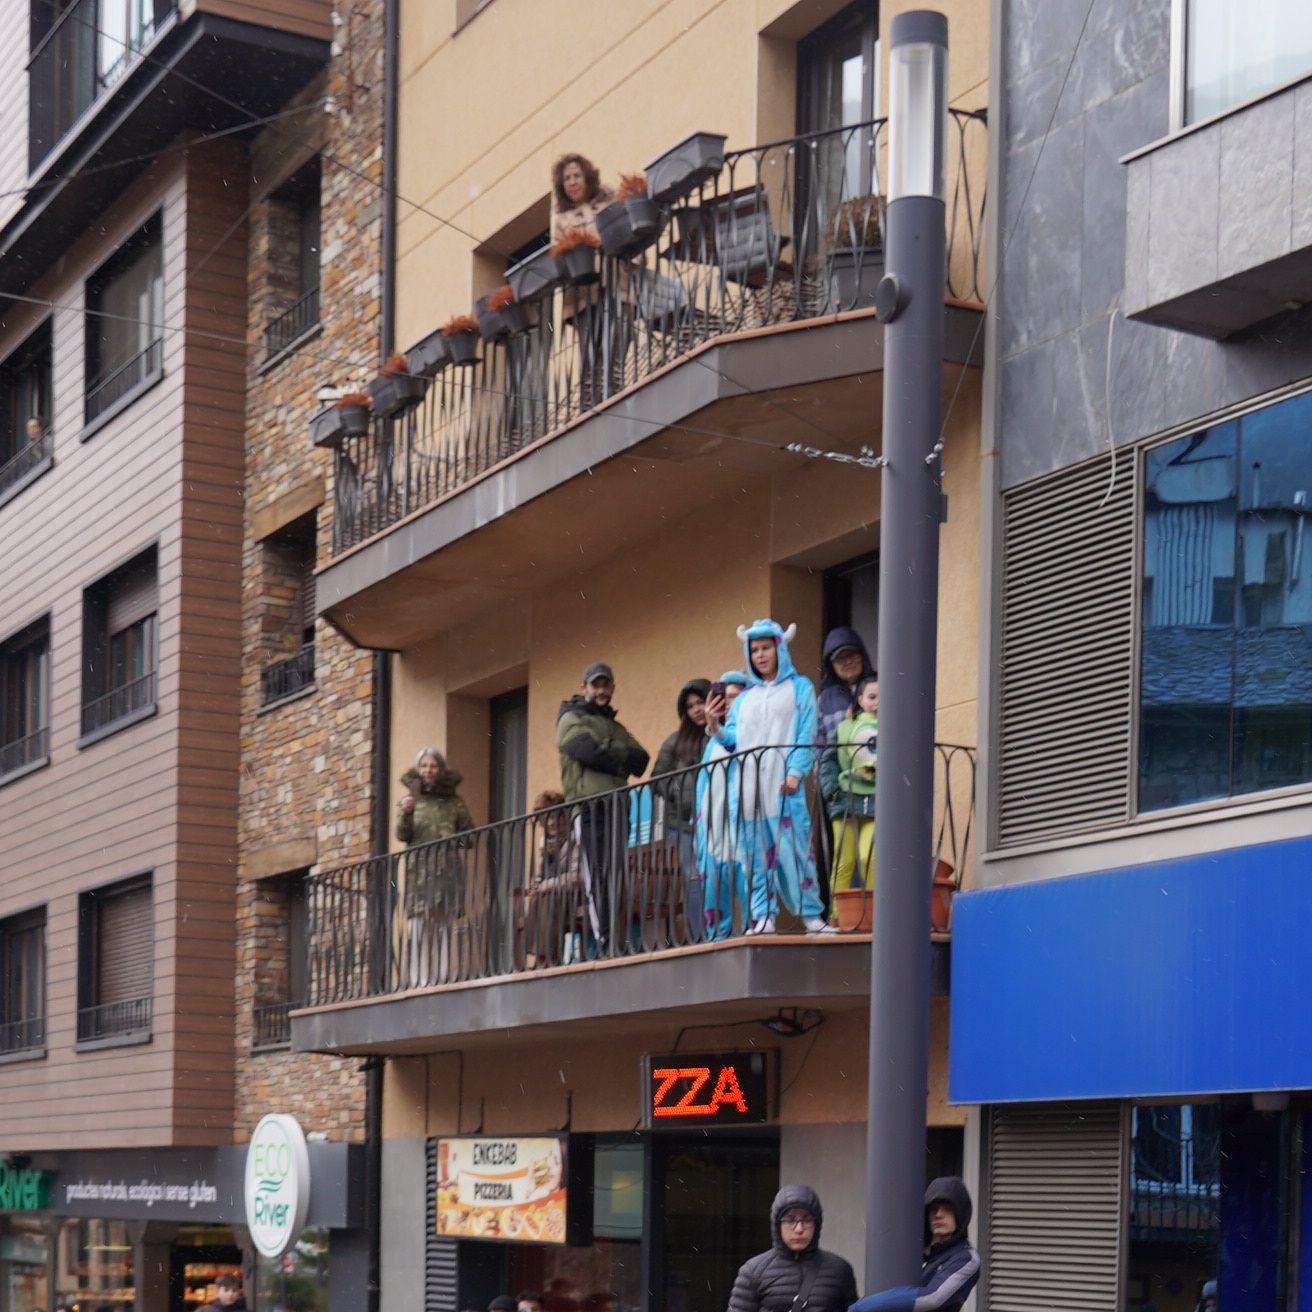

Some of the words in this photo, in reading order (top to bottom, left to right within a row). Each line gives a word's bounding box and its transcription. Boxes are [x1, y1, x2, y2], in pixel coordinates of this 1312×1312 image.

[255, 1143, 290, 1177] ECO
[474, 1183, 513, 1200] PIZZERIA
[254, 1195, 290, 1228] River
